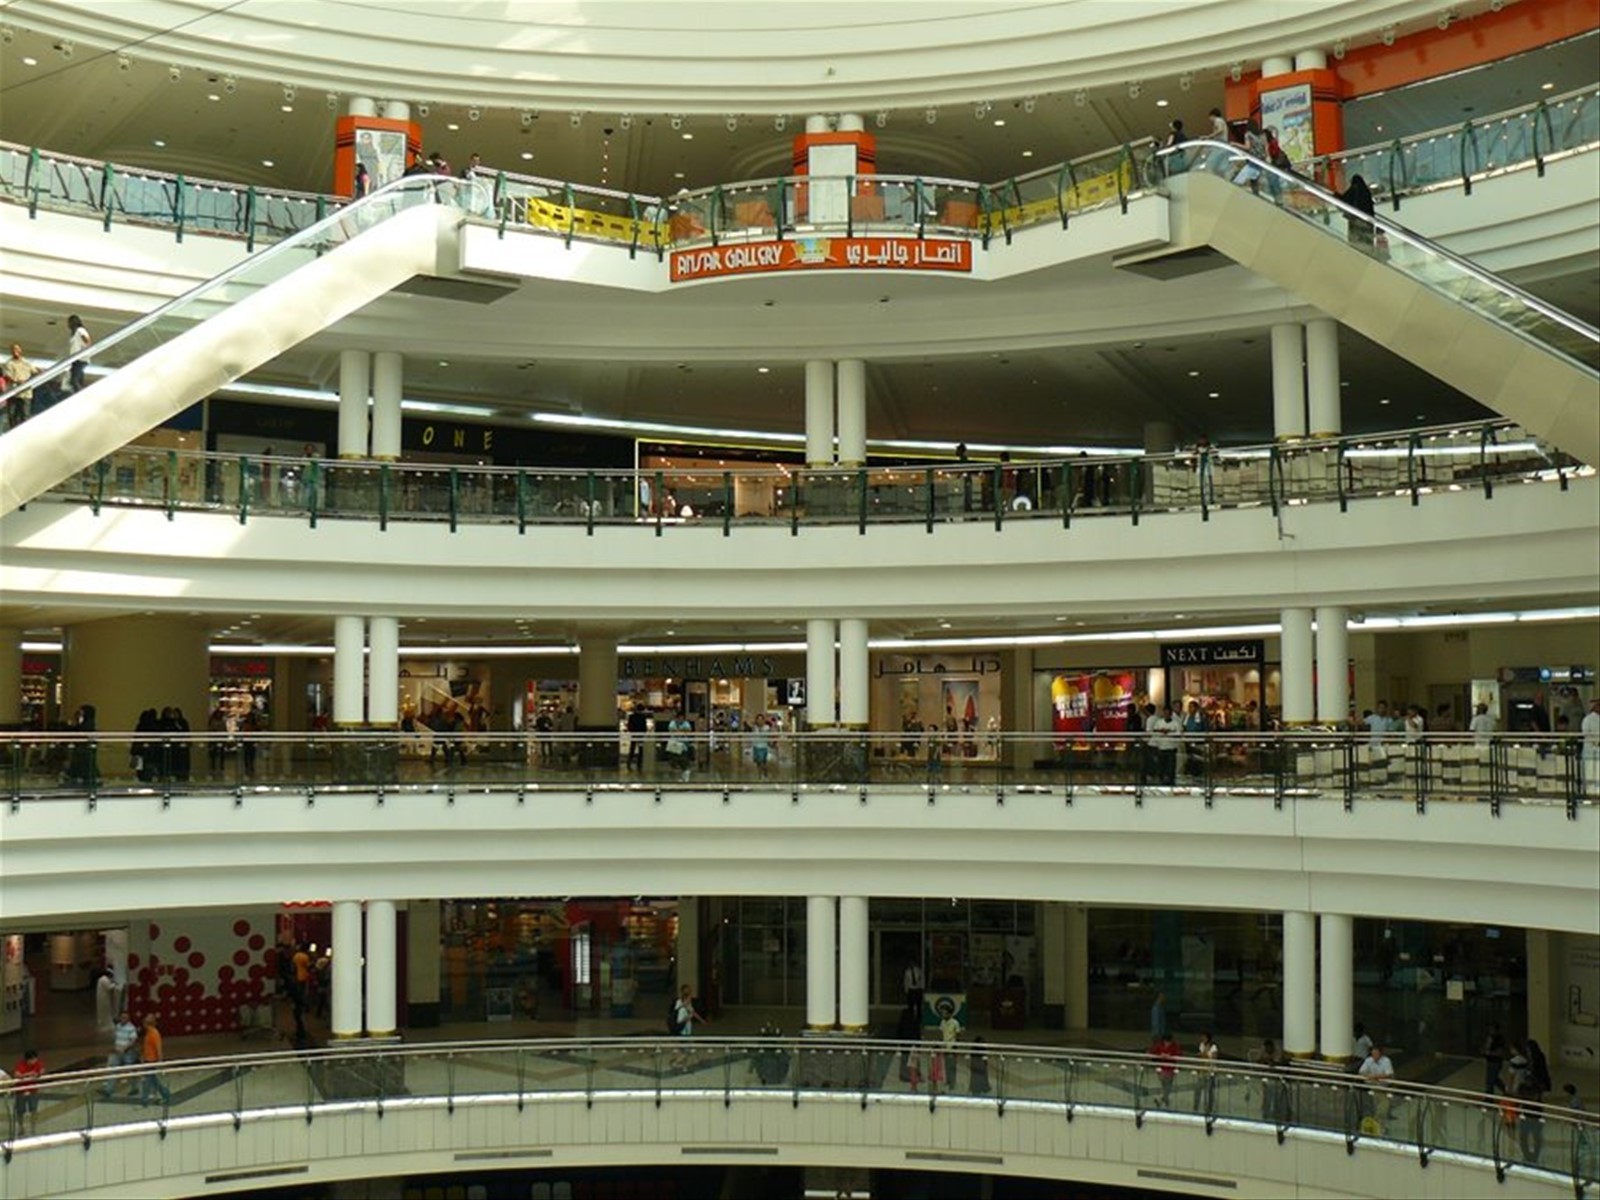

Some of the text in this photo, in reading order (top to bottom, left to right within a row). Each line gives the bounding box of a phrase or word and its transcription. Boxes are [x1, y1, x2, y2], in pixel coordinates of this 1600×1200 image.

[677, 245, 783, 275] ANSAR GALLERY
[1166, 647, 1208, 661] NEXT
